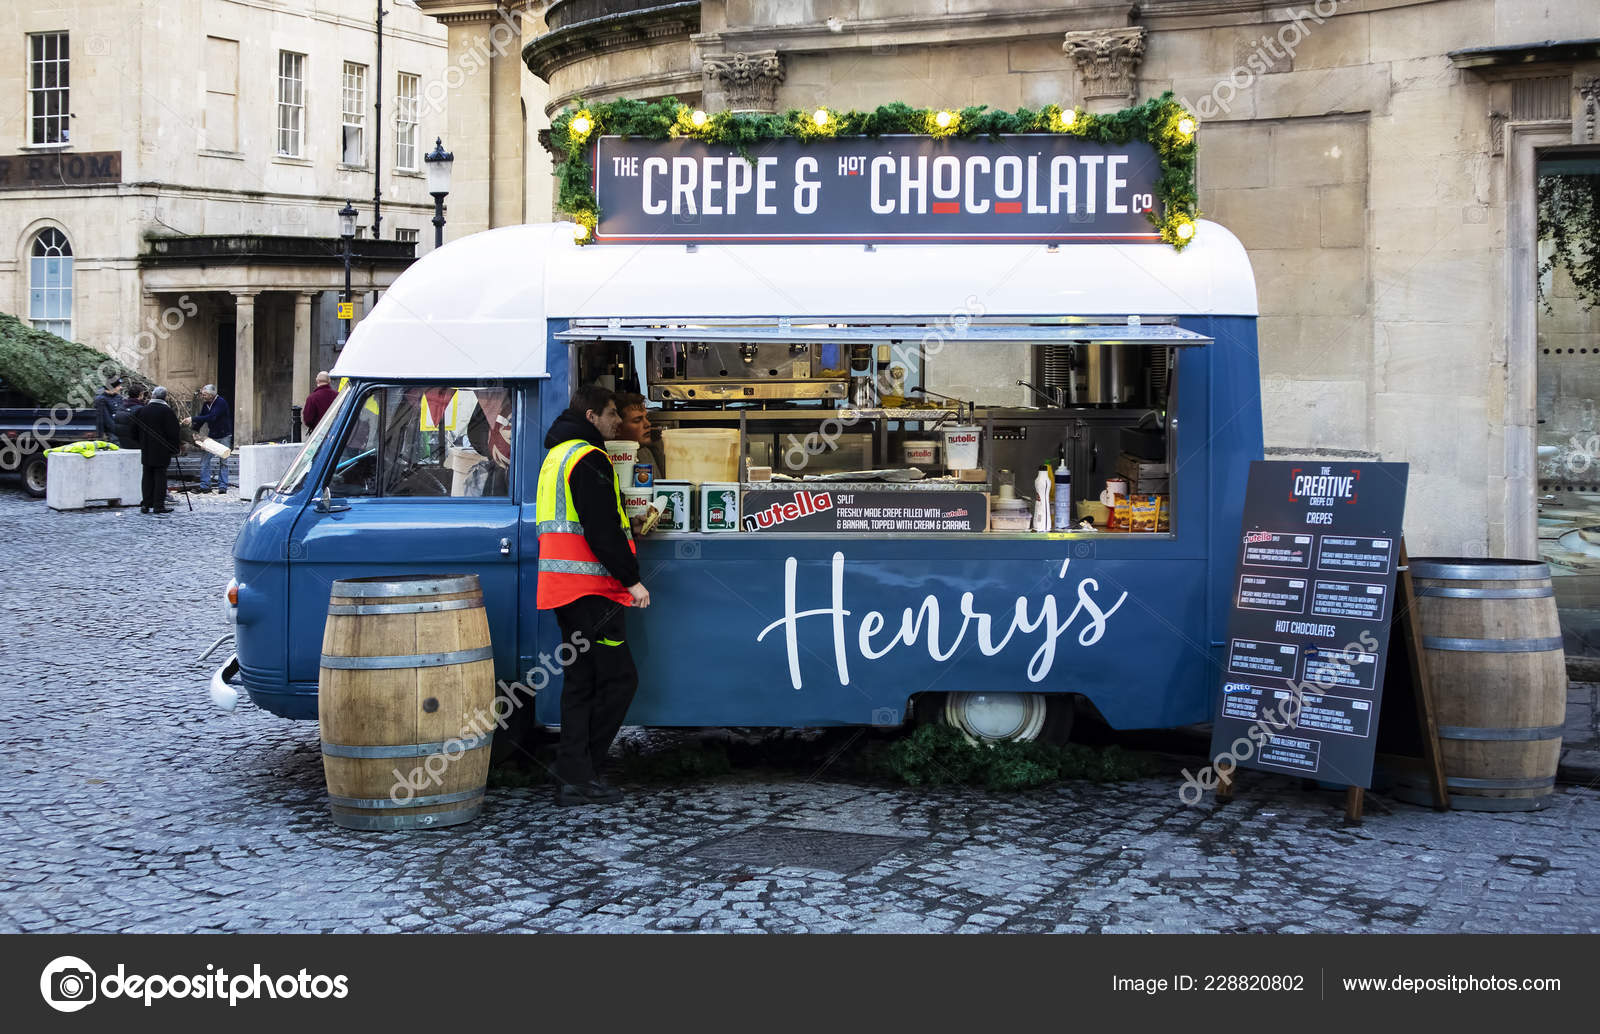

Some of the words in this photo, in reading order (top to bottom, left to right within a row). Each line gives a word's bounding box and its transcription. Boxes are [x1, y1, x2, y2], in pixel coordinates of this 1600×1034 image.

[613, 156, 639, 177] THE
[642, 156, 778, 215] CREPE
[793, 156, 821, 215] &
[838, 156, 866, 176] HOT
[871, 155, 1128, 214] CHOCOLATE
[1132, 193, 1152, 214] CO
[948, 434, 976, 444] nutella
[608, 453, 632, 461] utella
[1321, 466, 1332, 475] THE
[1294, 476, 1354, 497] CREATIVE
[837, 494, 855, 505] SPLIT
[1309, 497, 1326, 505] CREPE
[742, 491, 833, 532] nutella
[836, 508, 862, 518] FRESHLY
[863, 508, 881, 518] MADE
[882, 508, 902, 518] CREPE
[903, 508, 923, 518] FILLED
[924, 508, 941, 518] WITH
[1306, 512, 1333, 525] CREPES
[836, 519, 842, 530] &
[842, 519, 870, 531] BANANA,
[871, 519, 896, 530] TOPPED
[896, 519, 912, 530] WITH
[913, 519, 936, 530] CREAM
[936, 519, 942, 530] &
[942, 519, 971, 530] CARAMEL
[1243, 531, 1272, 544] nutella
[757, 551, 1128, 690] Henry's
[1275, 620, 1290, 633] HOT
[1290, 621, 1336, 638] CHOCOLATES
